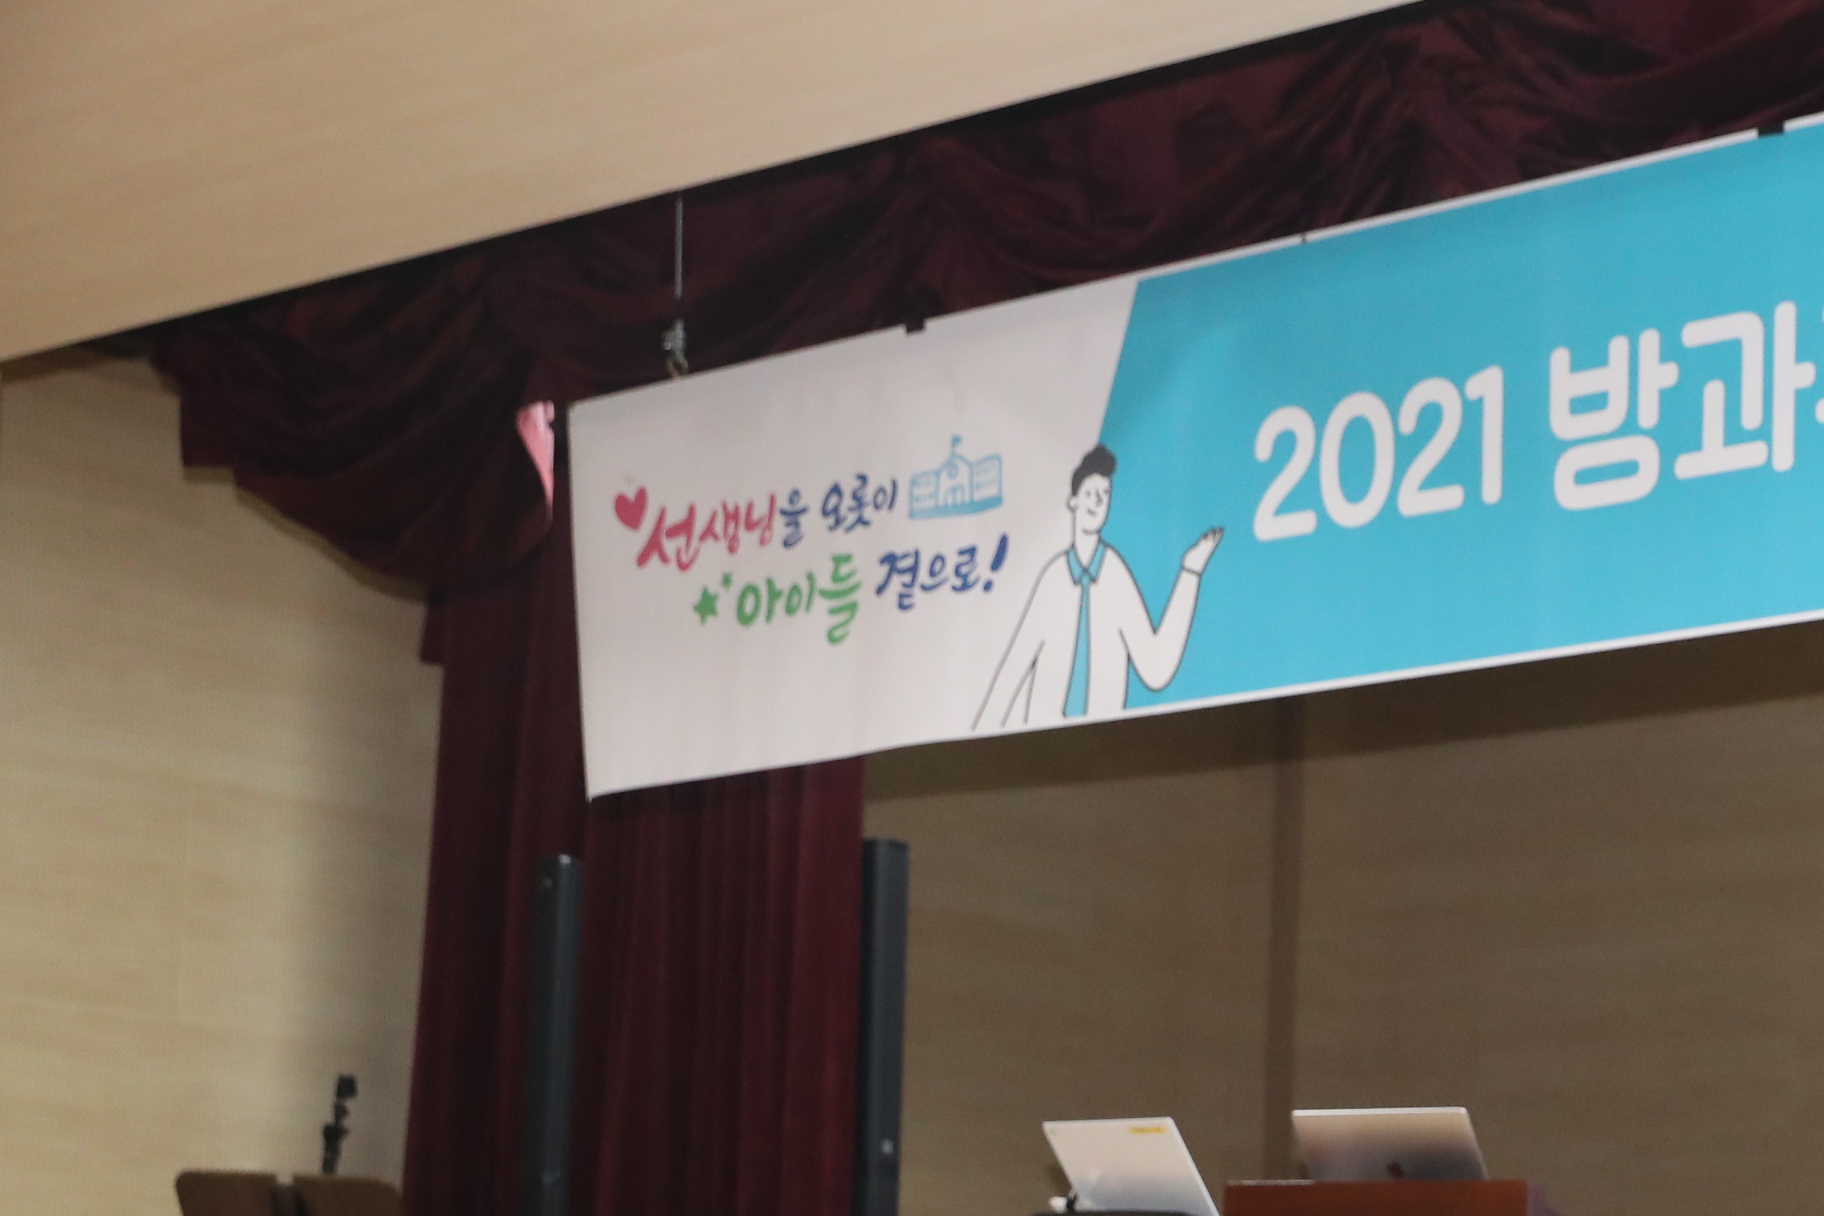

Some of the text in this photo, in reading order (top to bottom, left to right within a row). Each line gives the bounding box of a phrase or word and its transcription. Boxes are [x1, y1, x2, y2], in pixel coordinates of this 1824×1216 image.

[1252, 366, 1504, 542] 2021
[636, 473, 898, 571] 선생님을 오롯이
[735, 533, 1010, 645] 아이들 곁으로!
